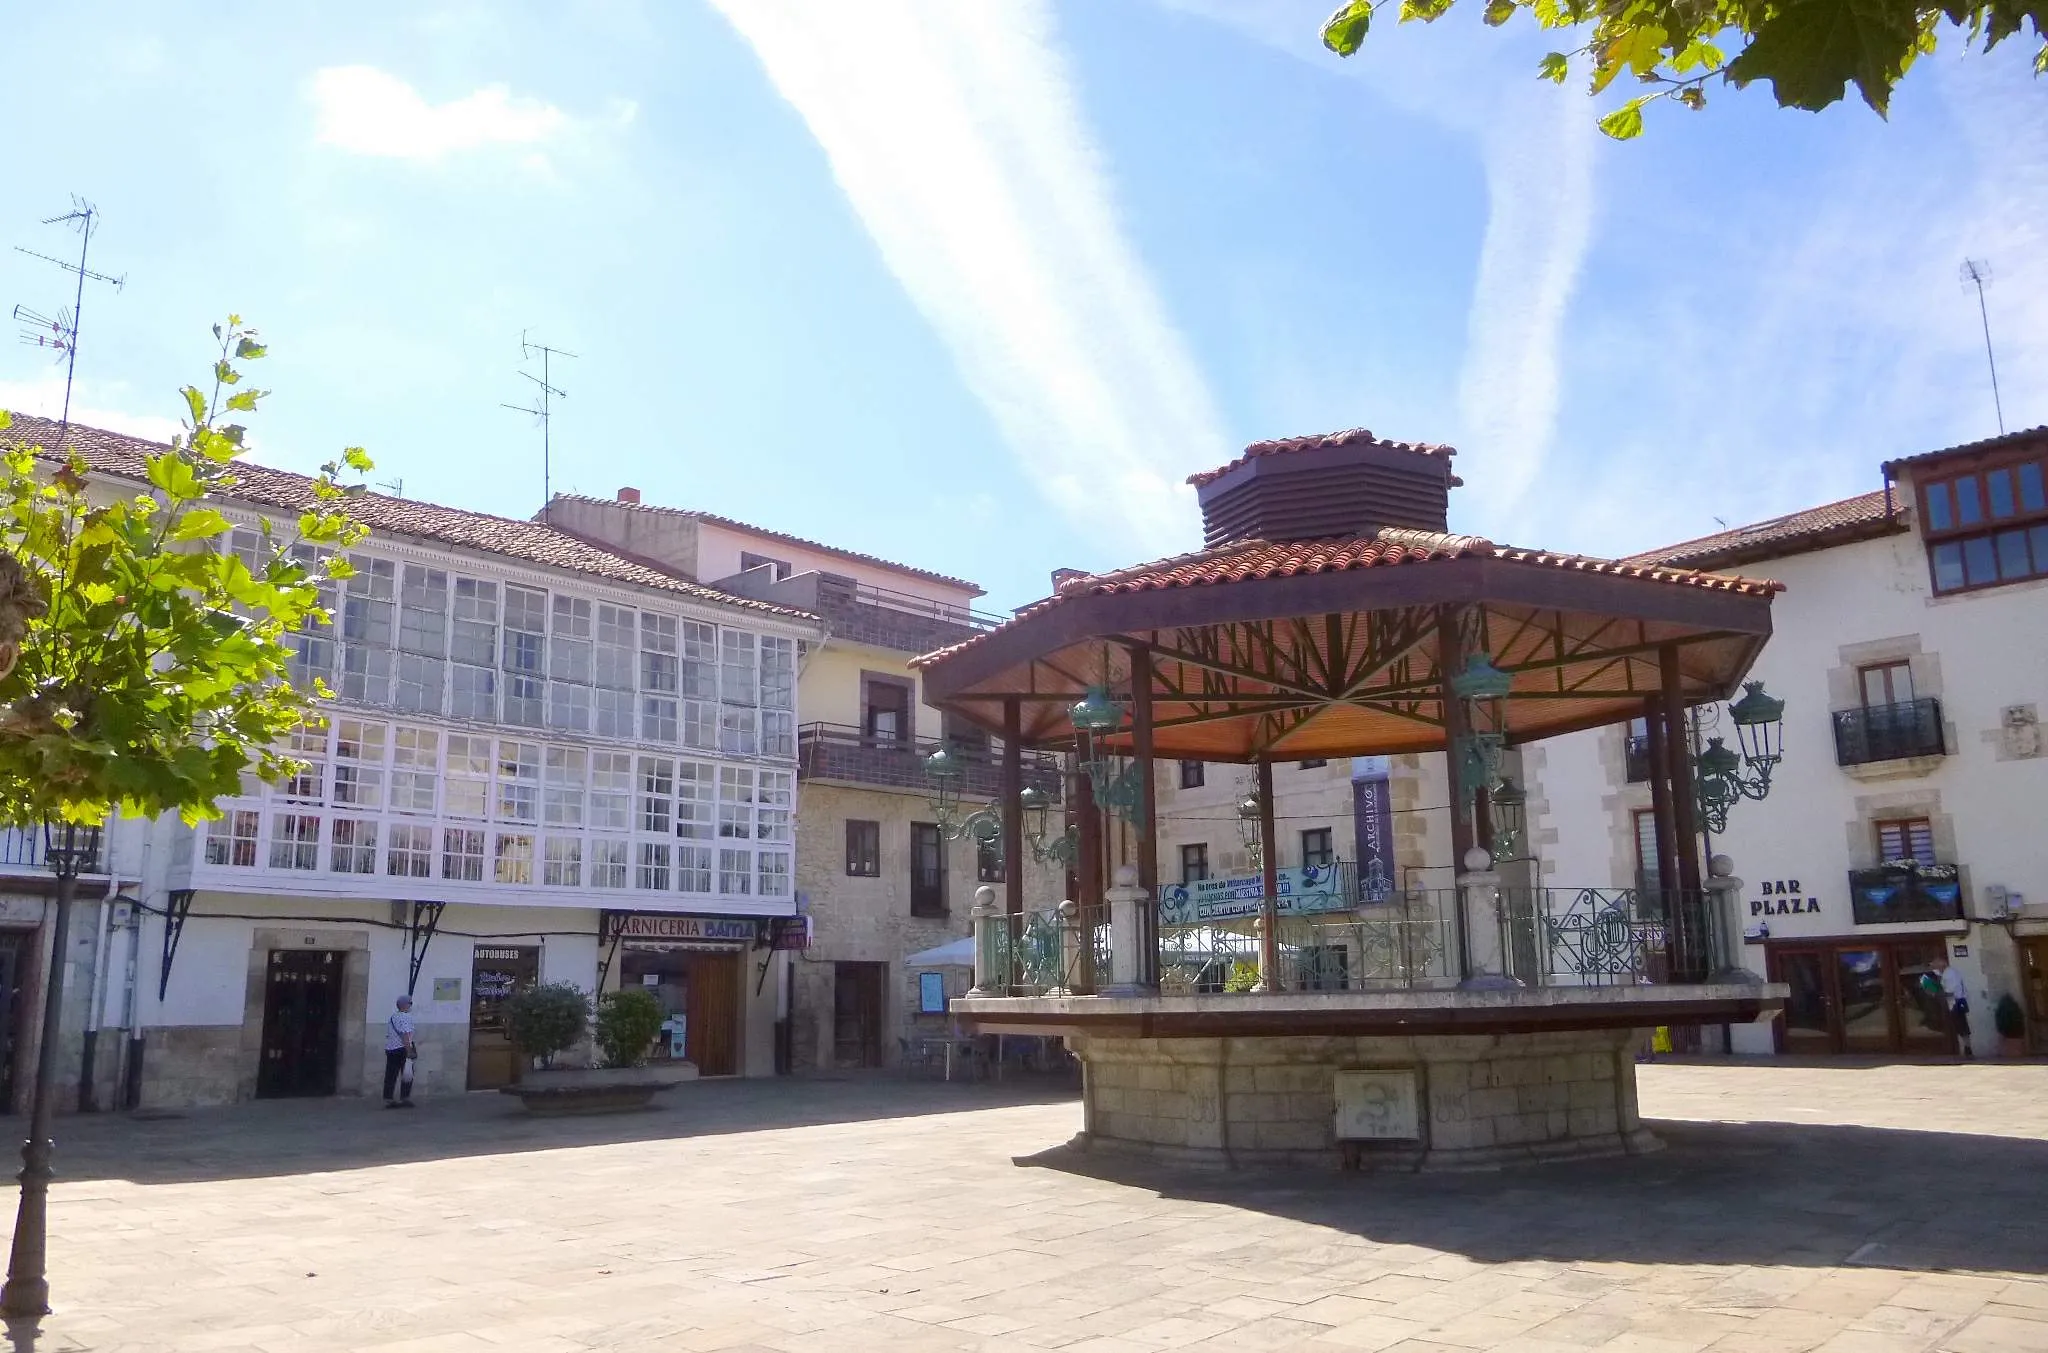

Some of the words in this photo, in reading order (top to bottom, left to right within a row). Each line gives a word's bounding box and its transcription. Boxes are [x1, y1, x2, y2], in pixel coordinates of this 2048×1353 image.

[1365, 790, 1376, 850] ARCHIVO
[1760, 880, 1801, 895] BAR
[1750, 897, 1821, 916] PLAZA
[474, 949, 520, 960] AUTOBUSES
